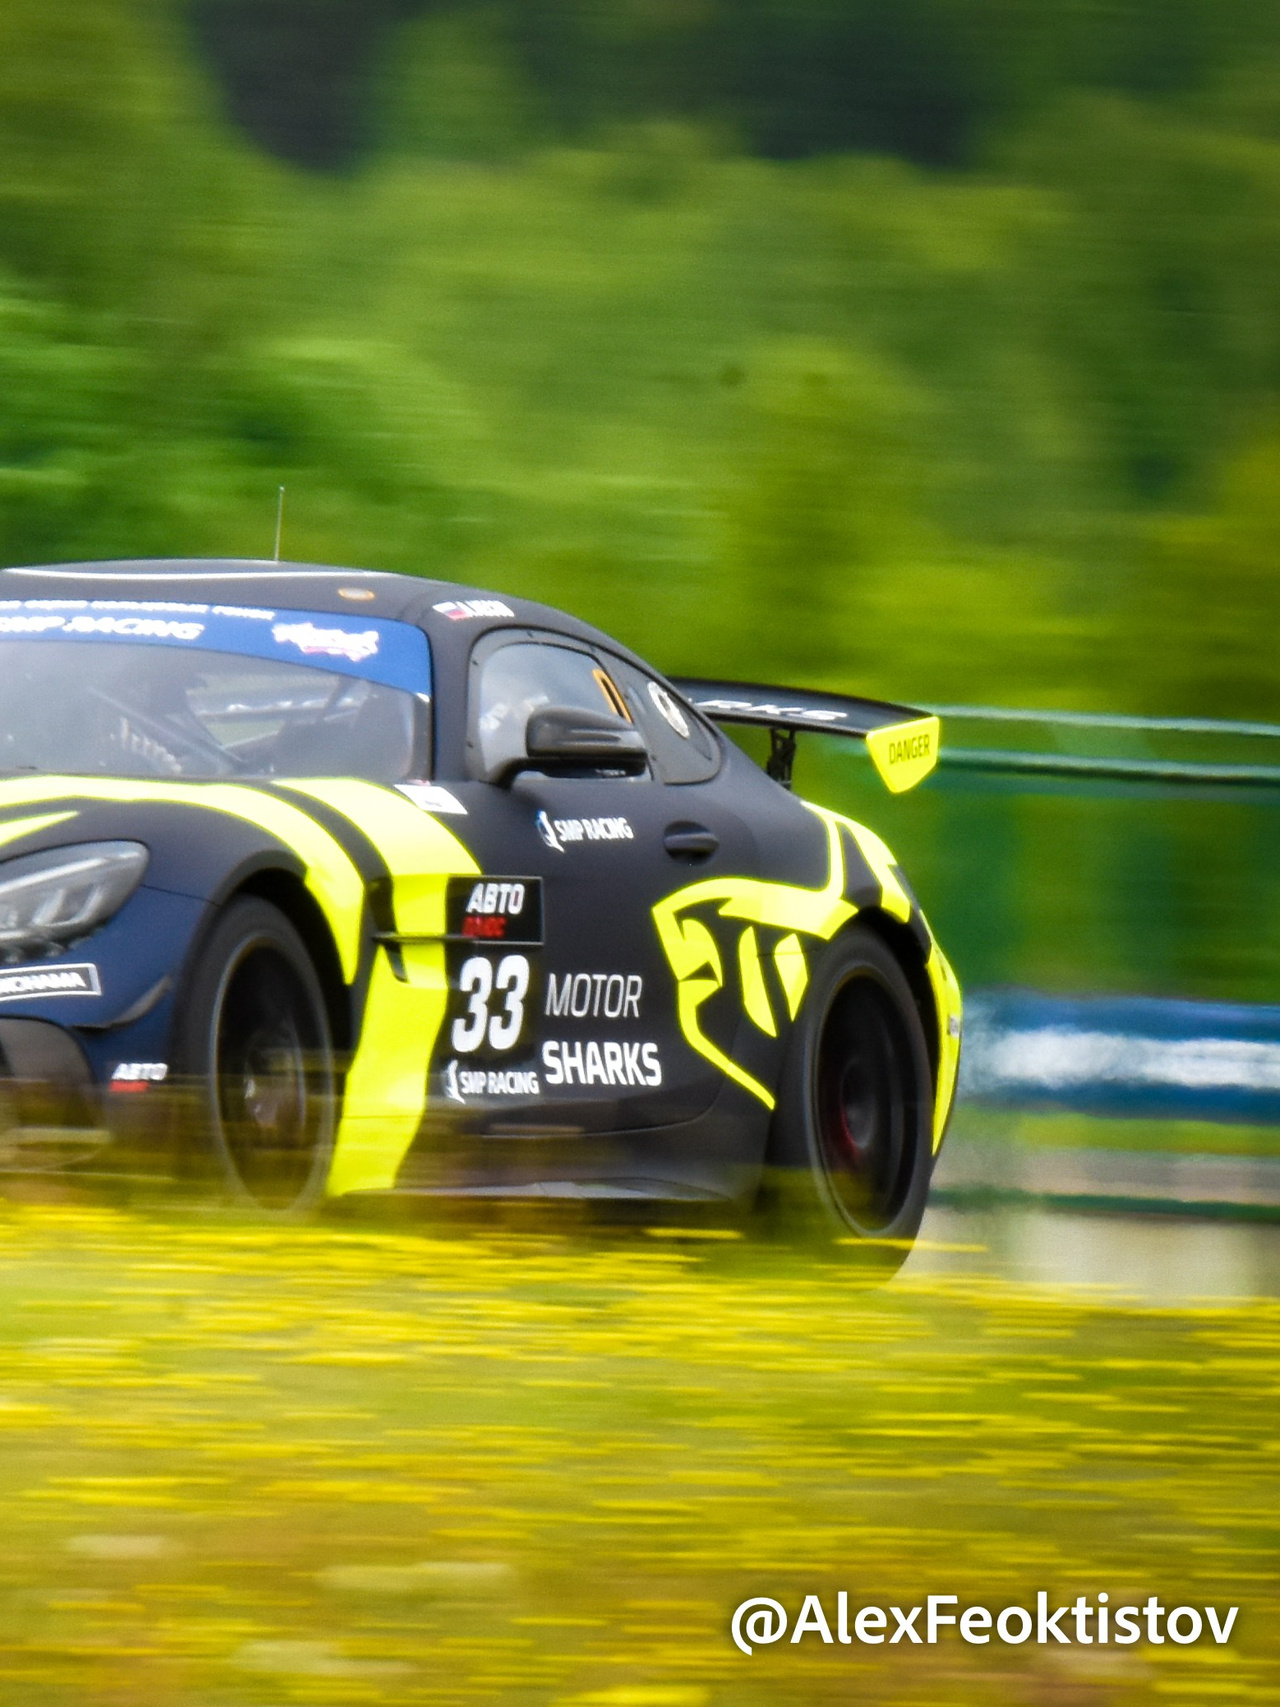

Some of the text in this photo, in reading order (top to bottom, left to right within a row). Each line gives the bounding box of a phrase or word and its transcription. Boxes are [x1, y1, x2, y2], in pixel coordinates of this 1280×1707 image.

[889, 734, 930, 765] DANGER
[582, 816, 634, 840] RACING
[451, 955, 530, 1053] 33
[545, 973, 643, 1018] MOTOR
[541, 1041, 662, 1086] SHARKS
[460, 1071, 540, 1095] SMP RACING
